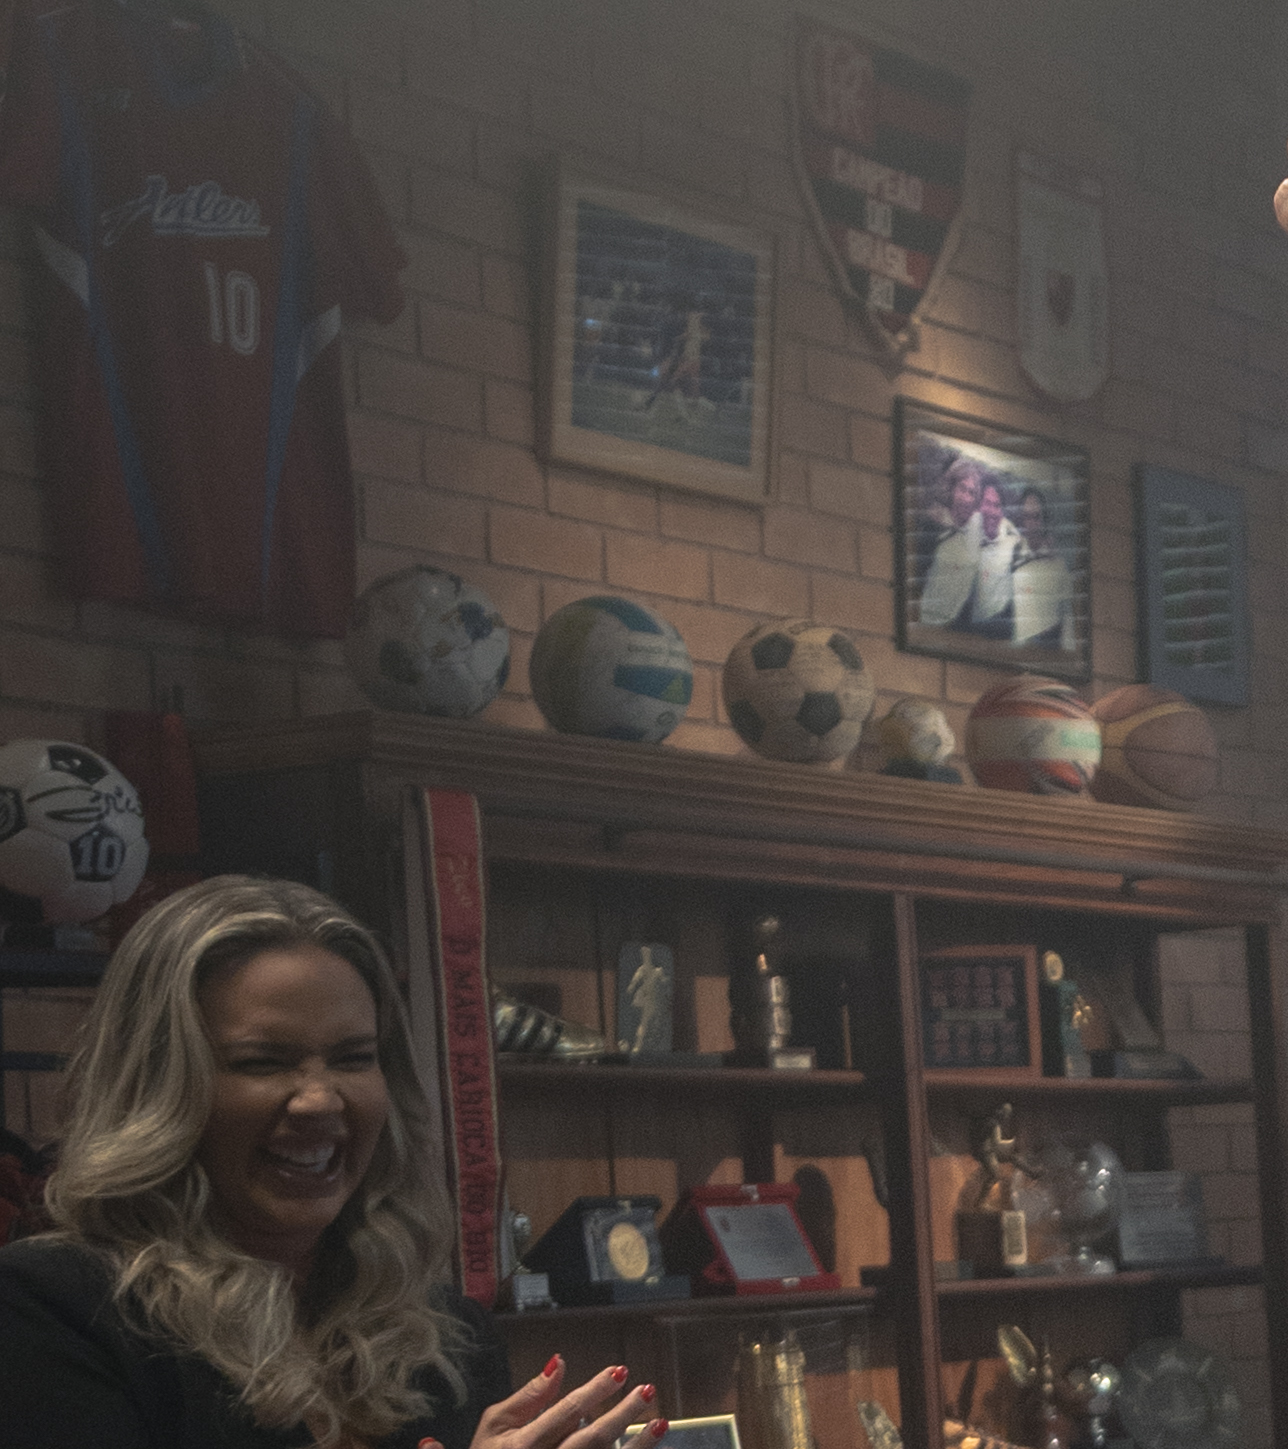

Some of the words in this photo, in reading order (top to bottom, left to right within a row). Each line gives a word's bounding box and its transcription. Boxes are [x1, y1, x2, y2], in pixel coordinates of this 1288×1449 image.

[203, 260, 261, 357] 10
[76, 834, 122, 876] 10
[451, 970, 477, 1038] MAIS
